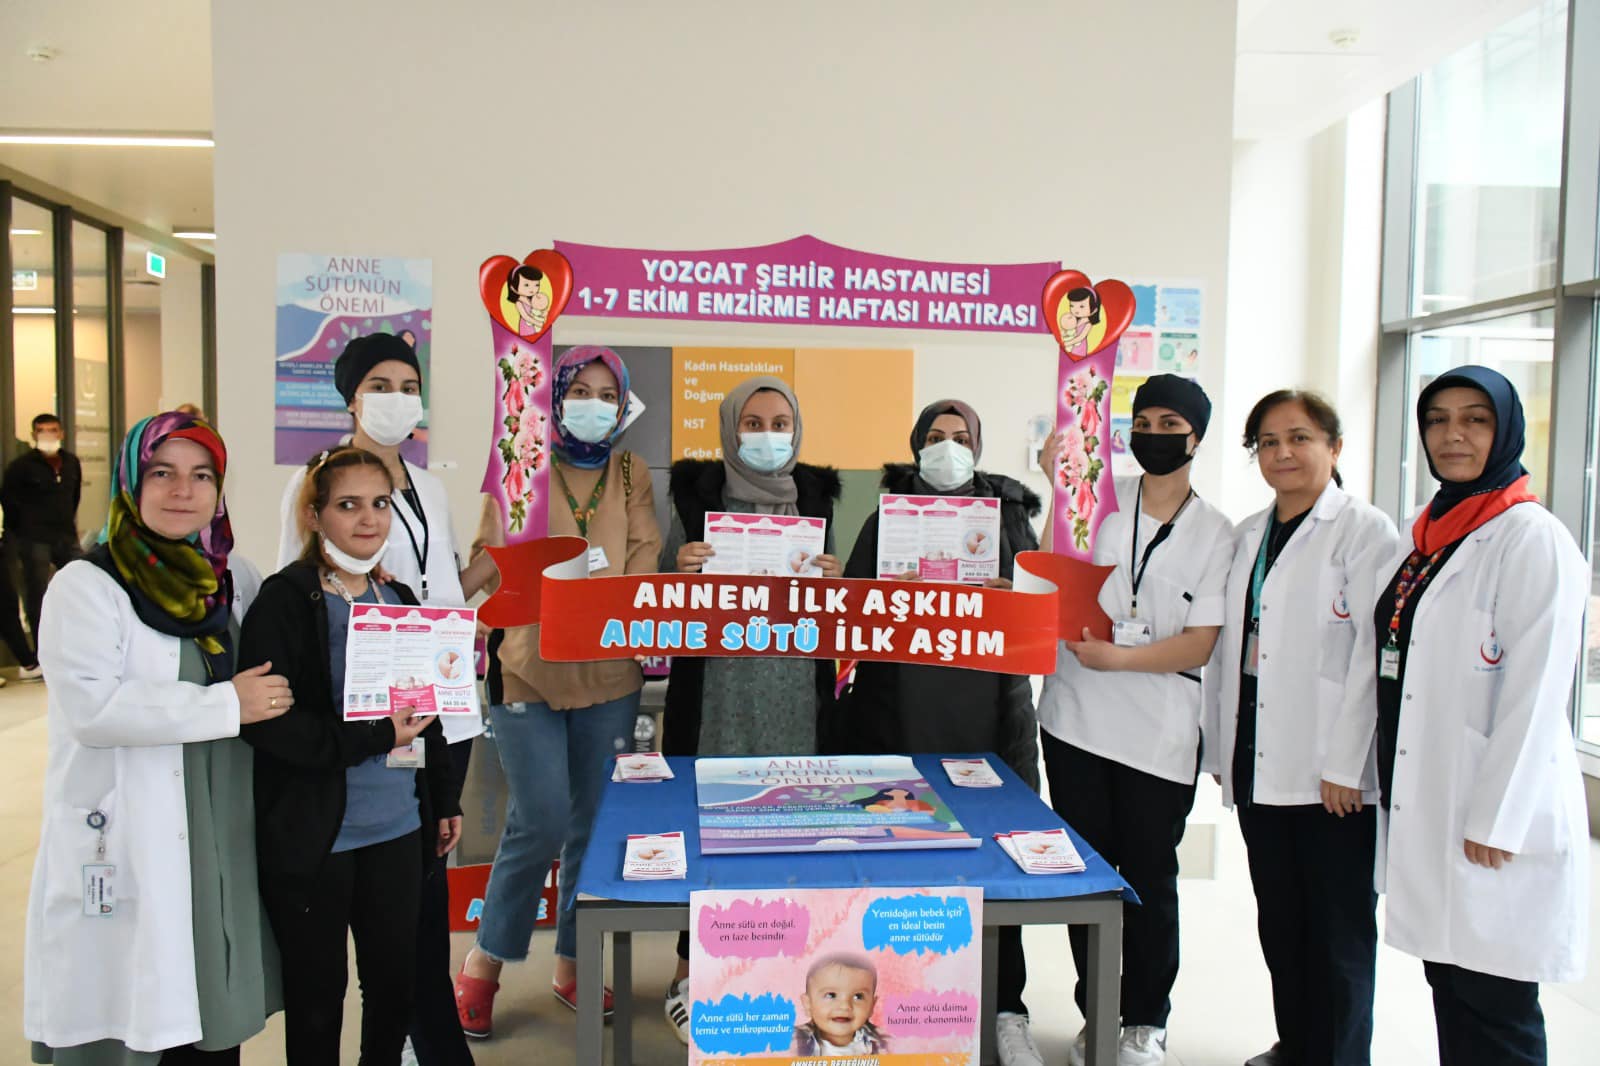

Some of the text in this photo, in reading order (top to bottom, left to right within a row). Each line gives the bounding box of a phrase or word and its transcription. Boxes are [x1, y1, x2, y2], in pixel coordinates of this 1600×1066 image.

[327, 257, 381, 274] ANNE
[641, 258, 990, 296] YOZGAT ŞEHİR HASTANESİ
[304, 274, 401, 295] SÜTÜNÜN
[319, 294, 385, 313] ÖNEMİ
[578, 284, 1037, 327] 1-7 EKİM EMZİRME HAFTASI HATIRASI
[684, 360, 783, 374] Kadın Hastalıkları
[684, 376, 698, 386] ve
[684, 389, 724, 403] Doğum
[683, 418, 705, 429] NST
[683, 447, 712, 458] Gebe
[633, 579, 983, 622] ANNEM İLK AŞKIM
[600, 616, 1005, 662] ANNE SÜTÜ İLK AŞIM
[872, 908, 918, 919] Yenidoğan
[920, 907, 944, 917] bebek
[710, 920, 735, 929] Anne
[738, 920, 756, 929] sütü
[888, 920, 945, 930] en ideal besin
[719, 934, 730, 942] en
[732, 933, 749, 942] taze
[896, 1003, 920, 1012] Anne
[942, 1002, 968, 1012] daima
[698, 1012, 790, 1023] Anne sütü her zaman
[695, 1026, 718, 1035] temiz
